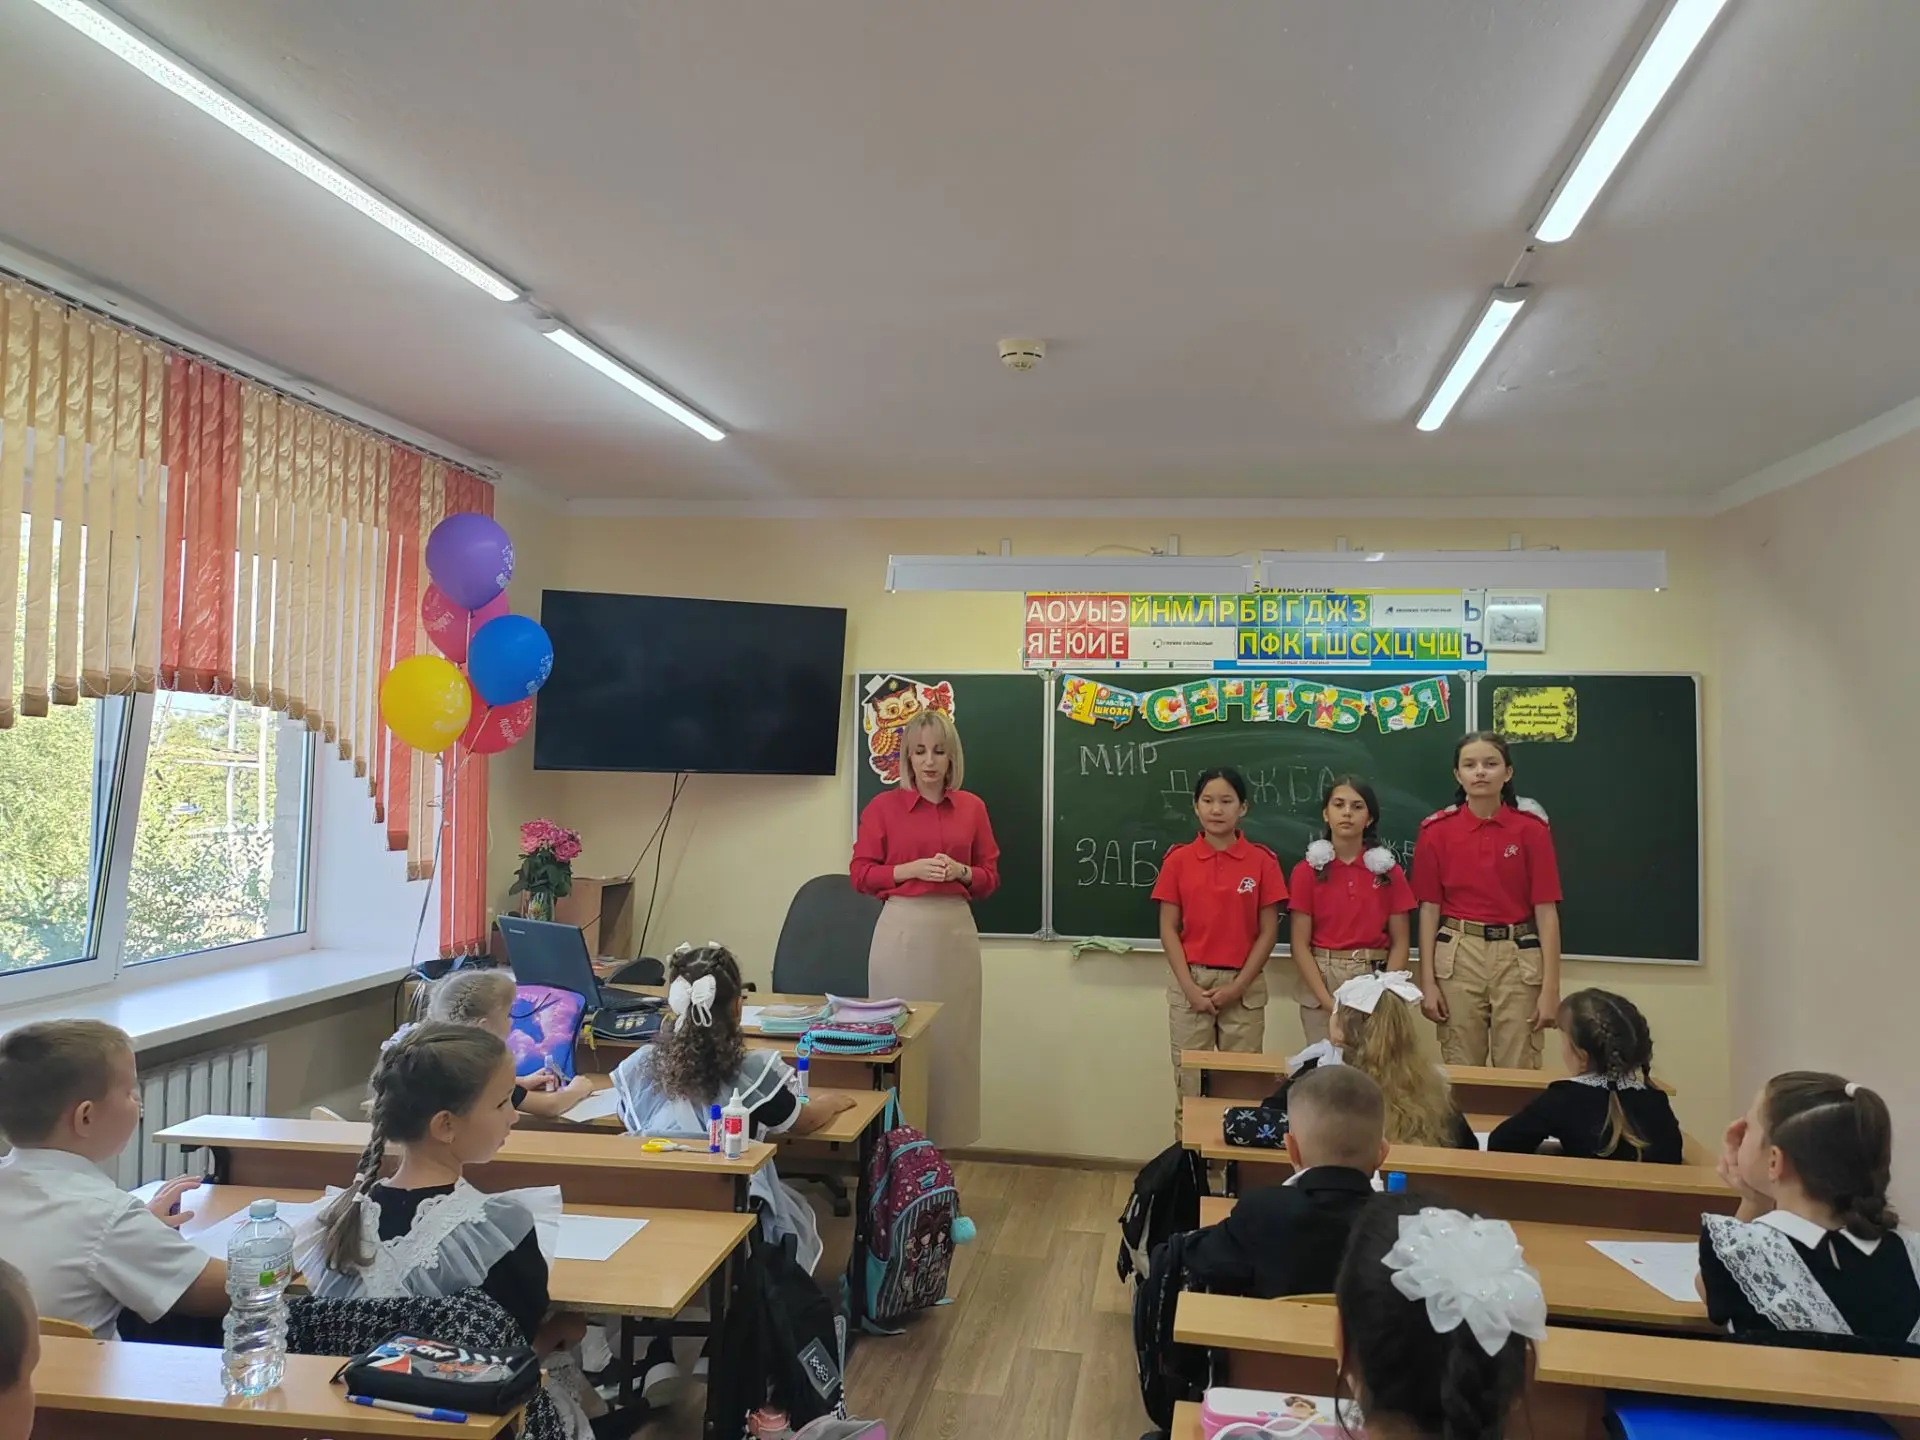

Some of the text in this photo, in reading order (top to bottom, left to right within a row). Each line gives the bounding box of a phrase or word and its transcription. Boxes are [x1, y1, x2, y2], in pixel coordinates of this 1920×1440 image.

[1147, 679, 1448, 733] СЕНТЯБРЯ
[1079, 741, 1158, 775] МИР
[1160, 764, 1336, 808] ДЖБА
